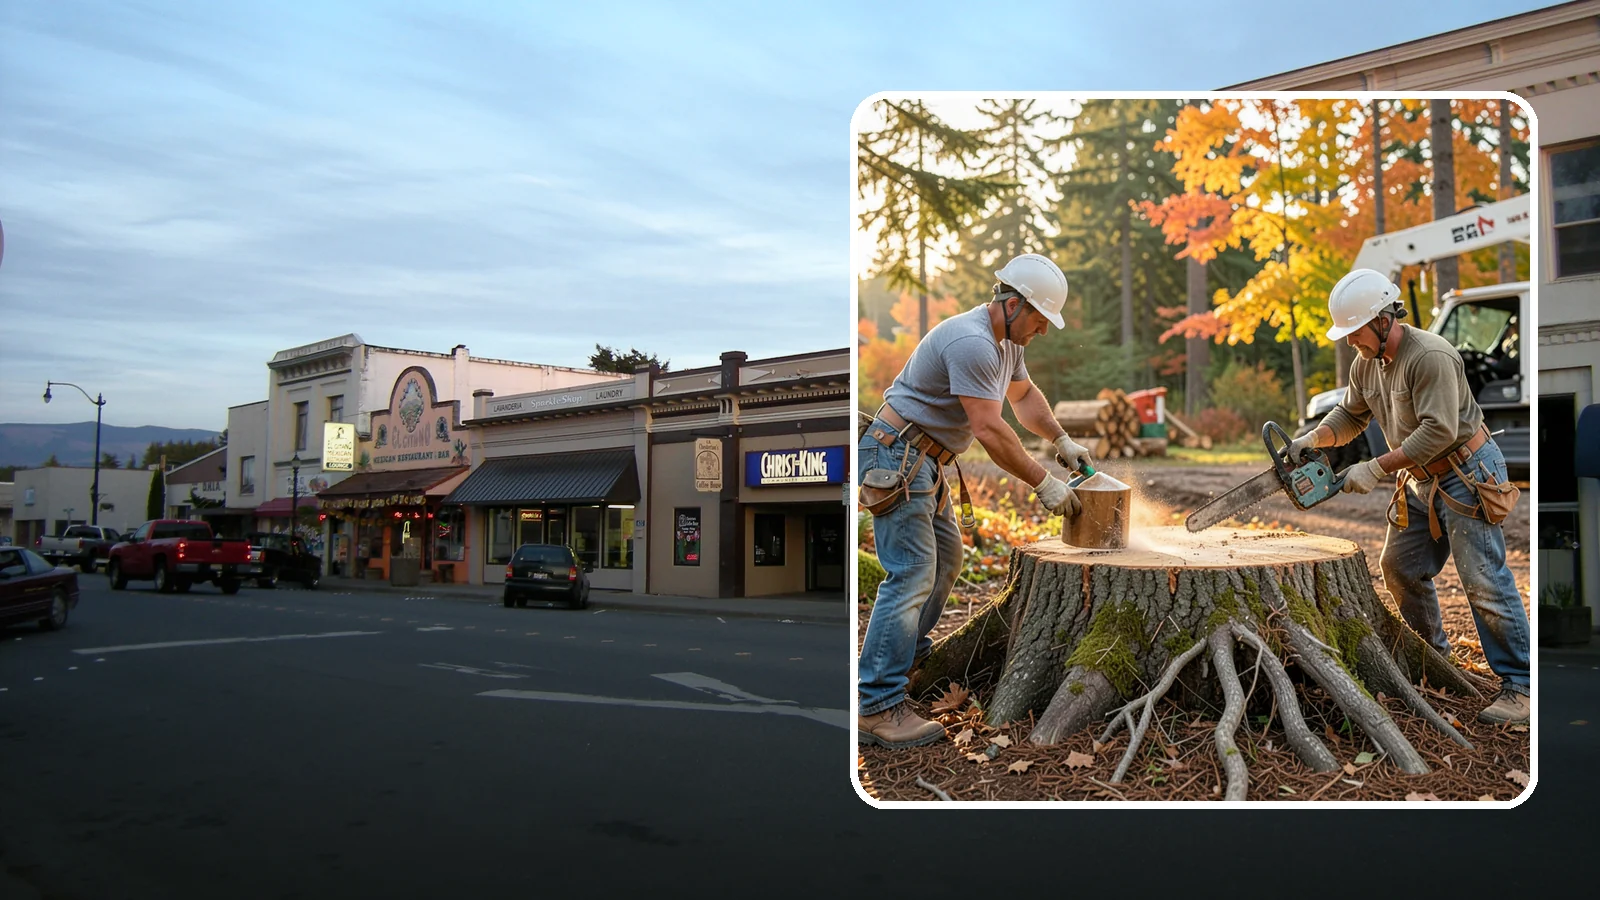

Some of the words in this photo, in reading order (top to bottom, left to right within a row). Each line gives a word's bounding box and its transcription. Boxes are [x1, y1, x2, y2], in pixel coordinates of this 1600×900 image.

[595, 388, 624, 400] LAUNDRY
[493, 402, 523, 412] LAVANDERIA
[374, 454, 396, 464] MEXICAN
[397, 451, 433, 462] RESTAURANT
[438, 450, 450, 459] BAR
[760, 452, 797, 478] CHRIST
[799, 450, 827, 477] KING
